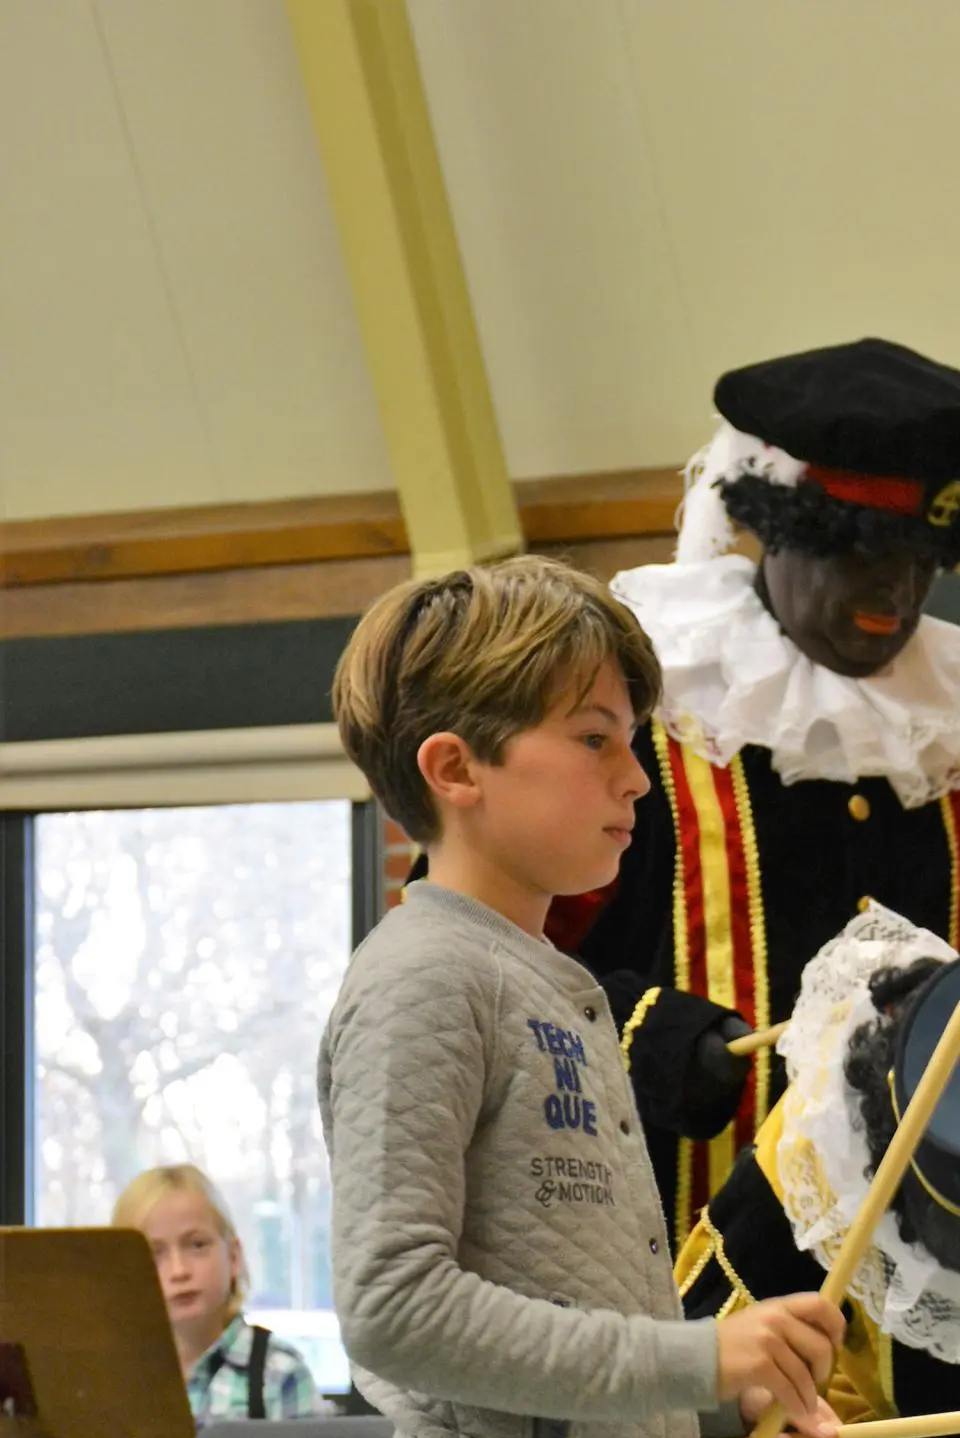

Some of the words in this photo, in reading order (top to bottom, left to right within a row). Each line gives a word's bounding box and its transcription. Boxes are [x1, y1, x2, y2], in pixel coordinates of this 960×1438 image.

[527, 1018, 588, 1068] TECH
[554, 1057, 582, 1093] NI
[544, 1094, 598, 1137] QUE
[530, 1157, 612, 1184] STRENGTH
[558, 1181, 616, 1207] MOTION
